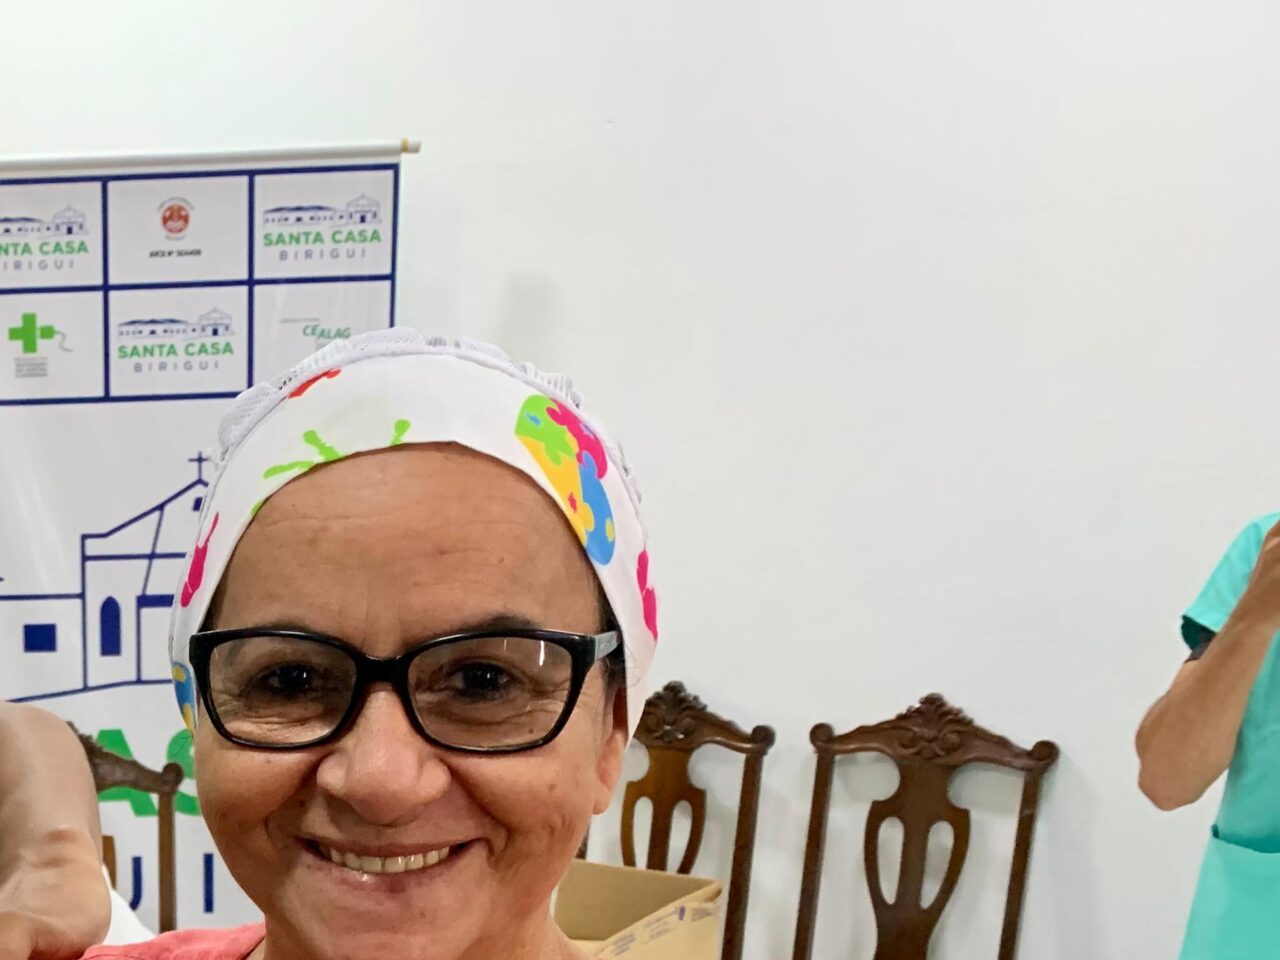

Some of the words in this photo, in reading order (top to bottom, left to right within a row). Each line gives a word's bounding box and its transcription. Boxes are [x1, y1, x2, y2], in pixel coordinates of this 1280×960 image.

[262, 229, 325, 247] SANTA
[331, 227, 382, 244] CASA
[39, 239, 89, 256] CASA
[279, 246, 366, 261] BIRIGUI
[117, 343, 178, 360] SANTA
[184, 340, 234, 357] CASA
[133, 360, 219, 374] BIRIGUI
